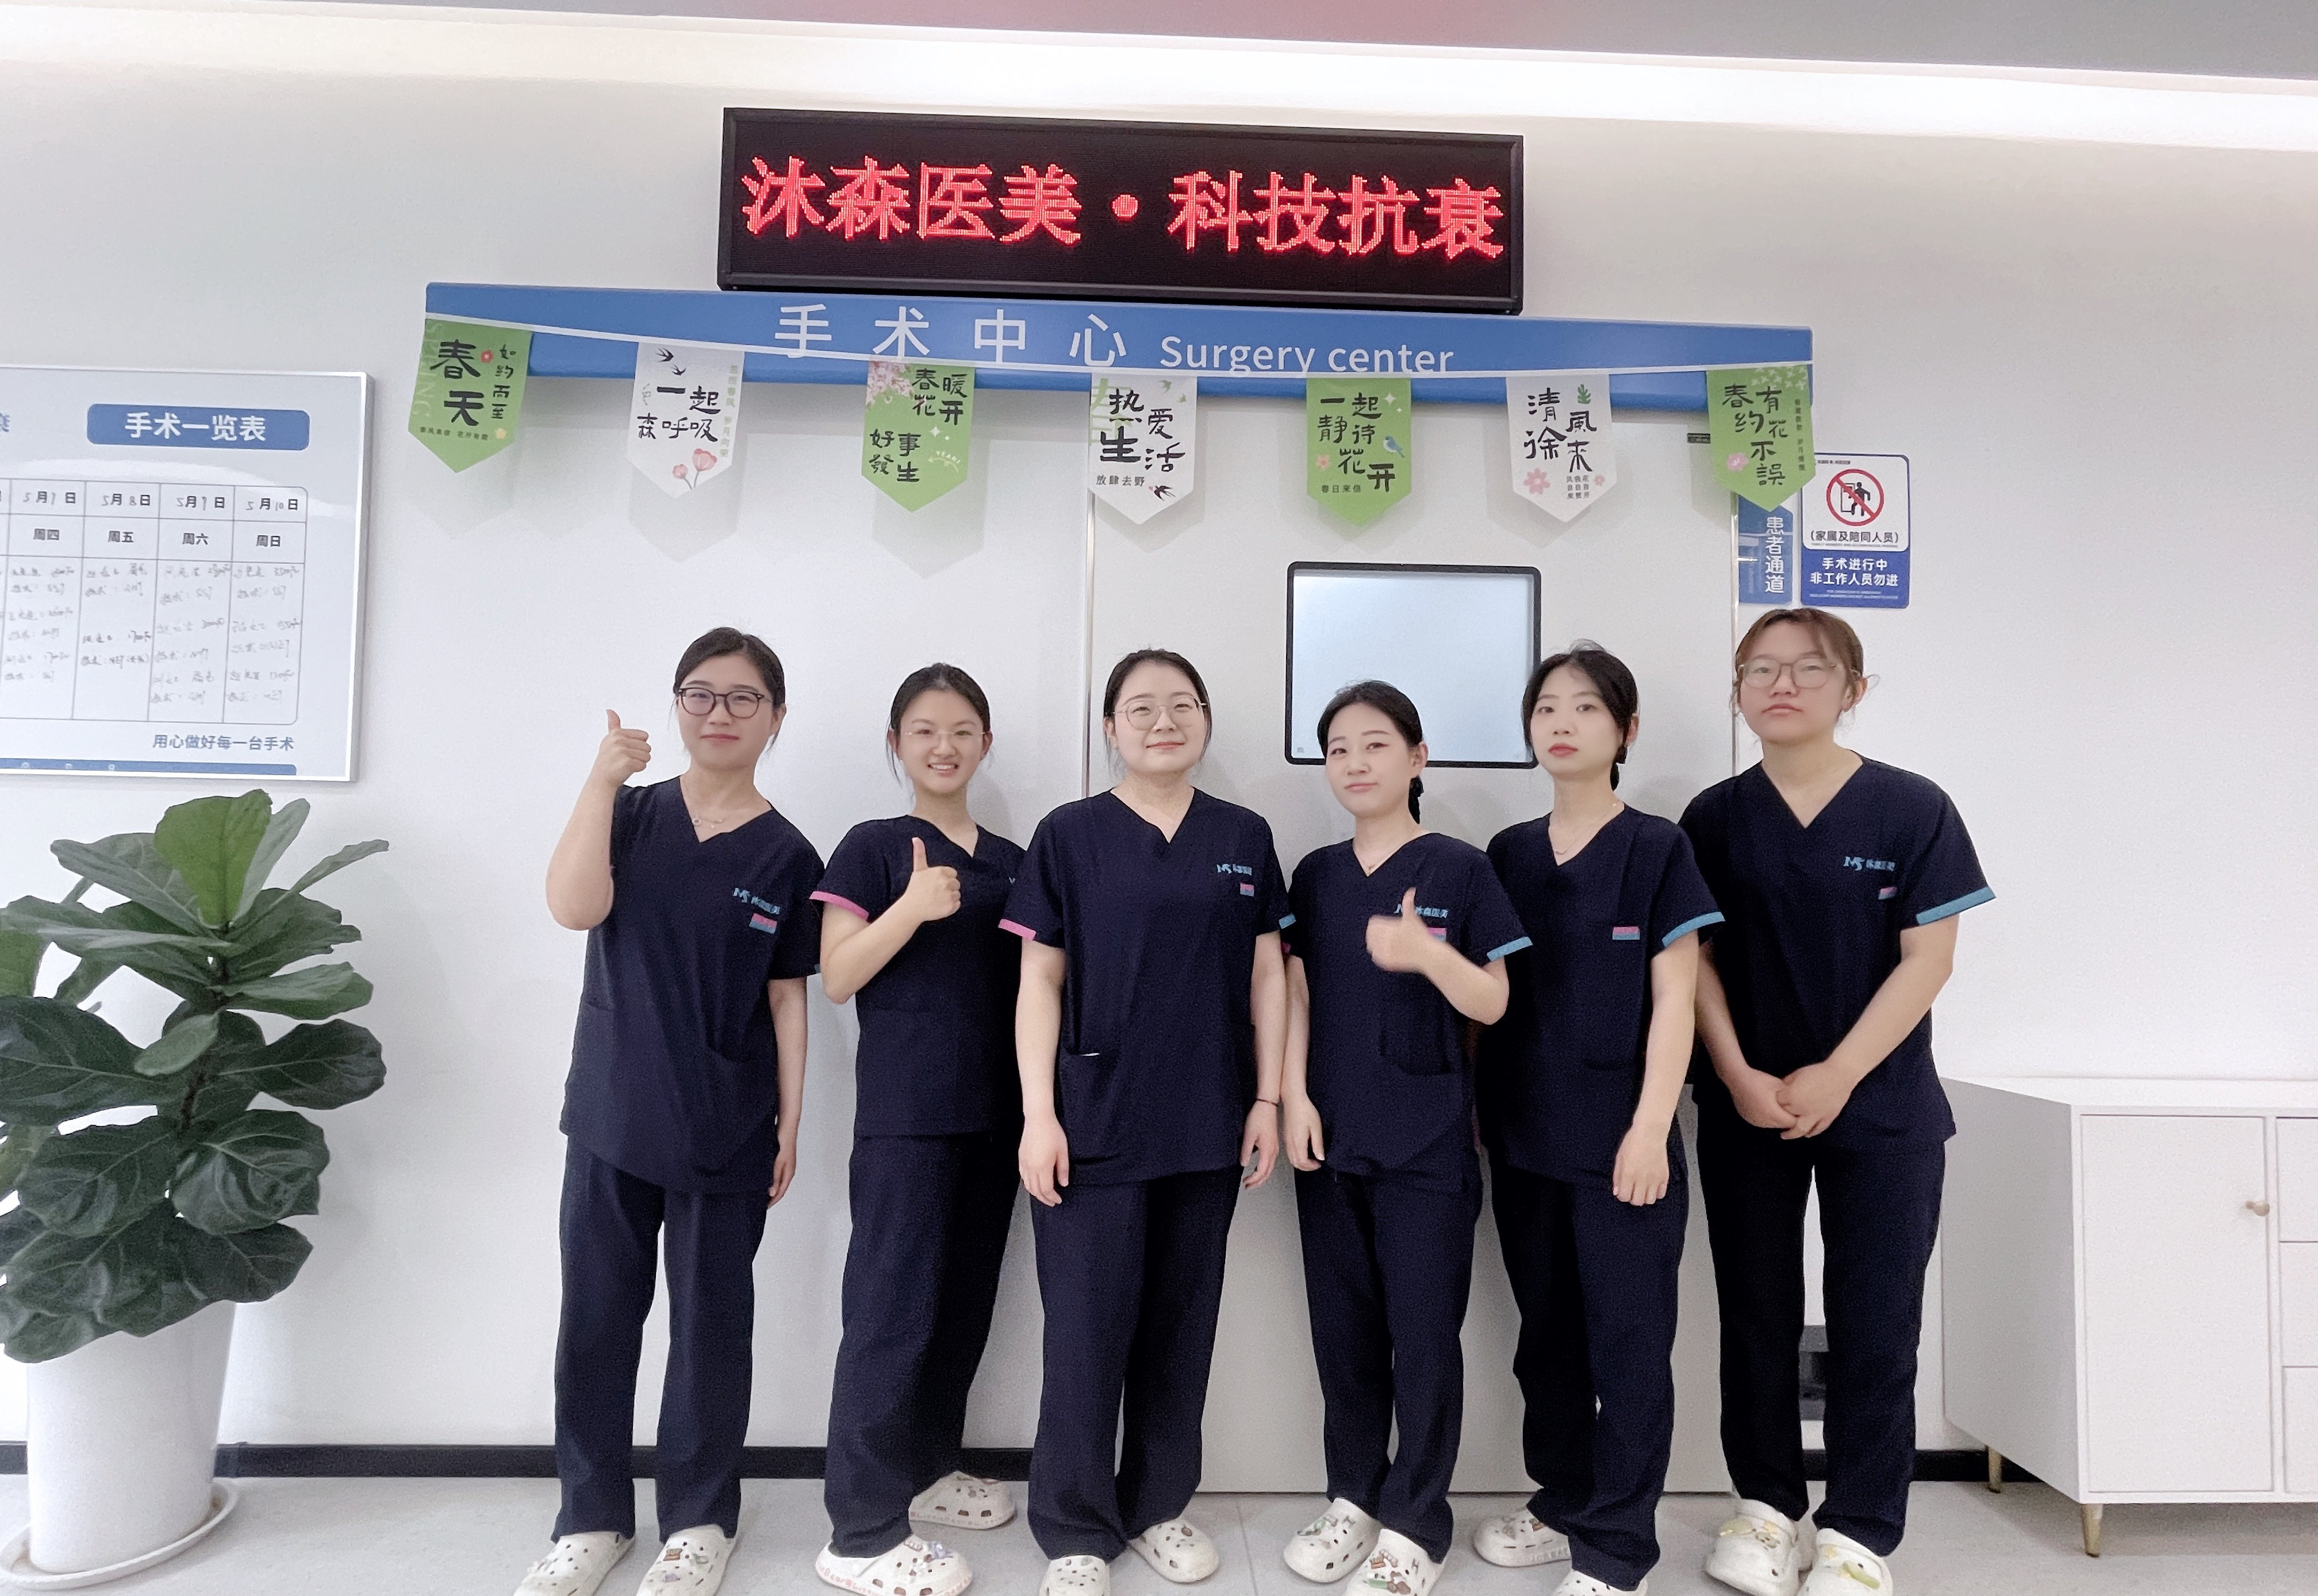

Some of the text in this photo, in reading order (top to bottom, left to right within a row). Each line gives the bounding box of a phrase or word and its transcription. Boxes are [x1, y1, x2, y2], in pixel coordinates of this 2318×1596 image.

[774, 304, 1127, 367] 手术中心
[1160, 335, 1455, 376] Surgery center
[429, 339, 485, 426] 春天
[657, 386, 721, 414] 一起
[1320, 392, 1381, 419] 一起
[124, 412, 266, 441] 手术一览表
[637, 413, 718, 442] 森呼吸
[1100, 426, 1185, 472] 生活
[33, 528, 59, 540] 周四
[108, 530, 135, 544] 周五
[182, 533, 209, 546] 周六
[256, 535, 282, 548] 周日
[1765, 516, 1784, 593] 患者通道
[1822, 557, 1888, 571] 手术进行中
[1810, 571, 1898, 587] 非工作人员勿进
[152, 734, 294, 751] 用心做好每一台手术
